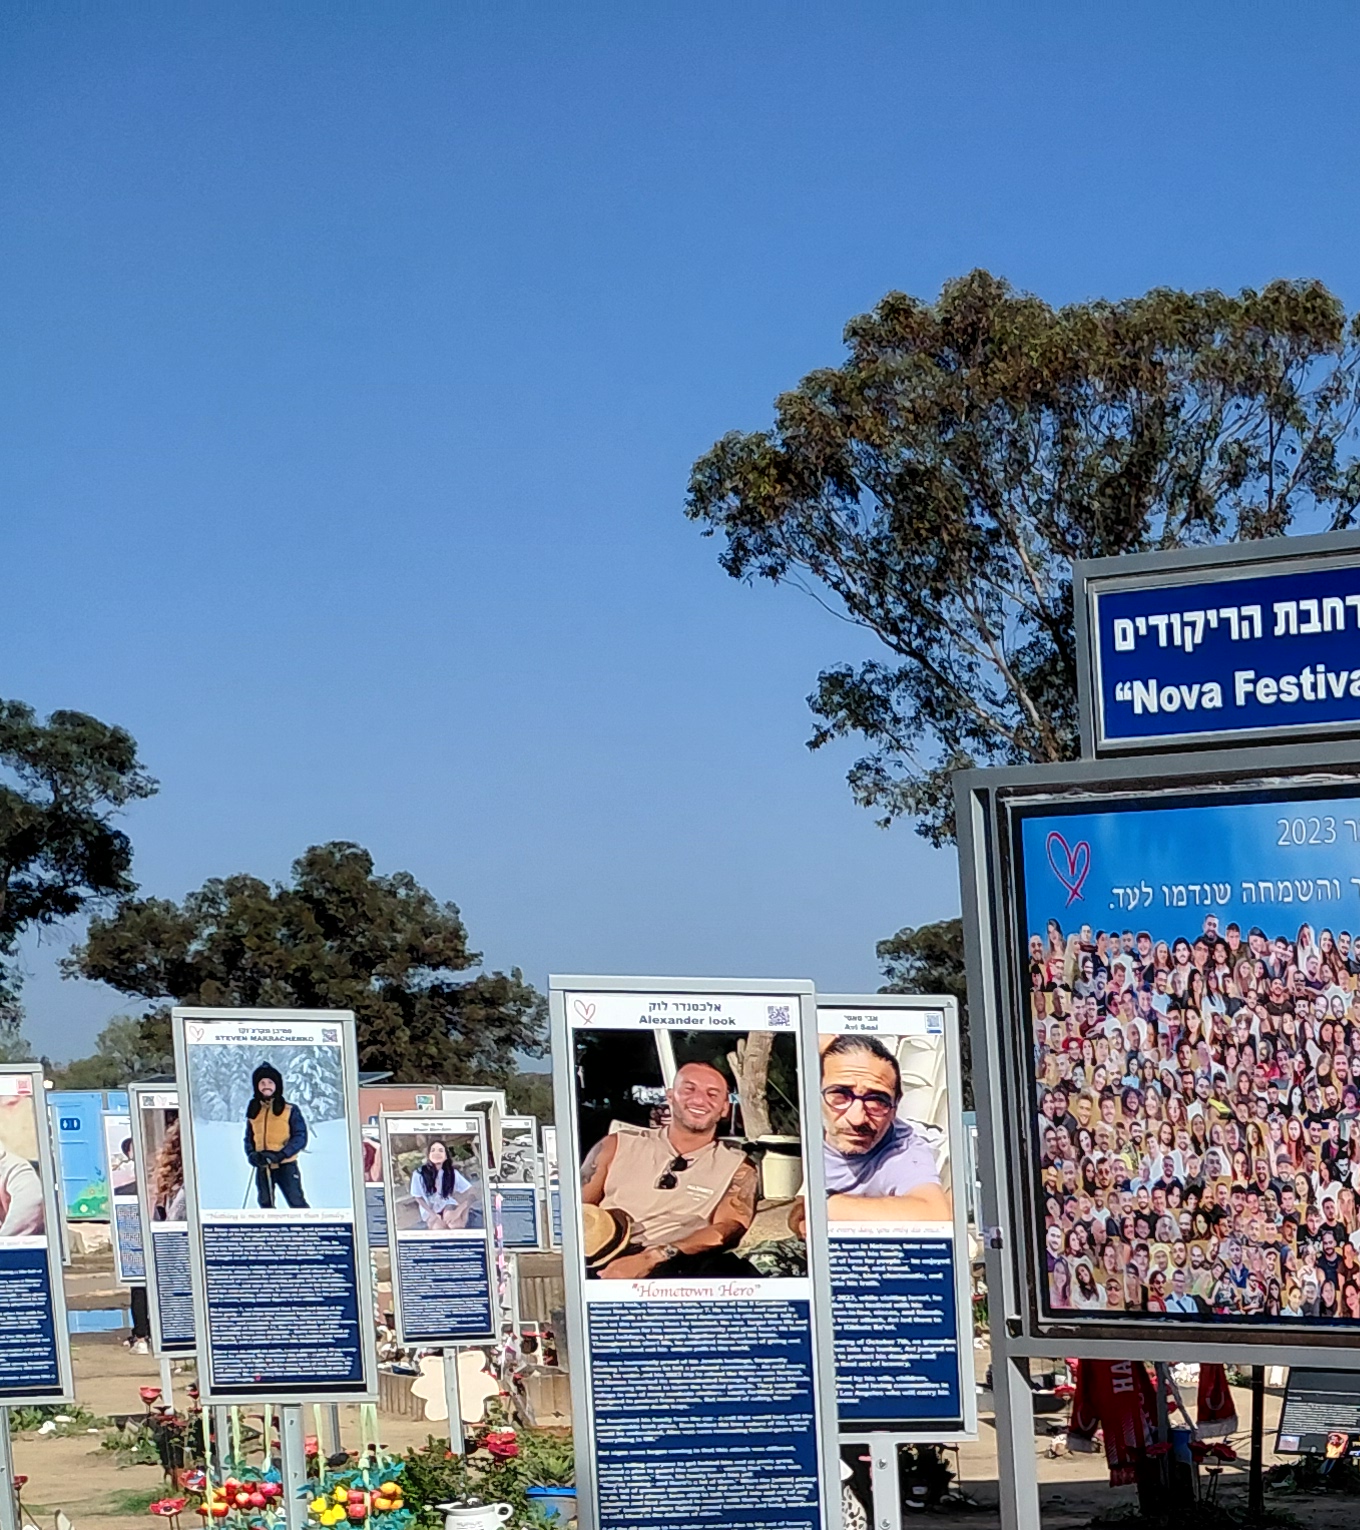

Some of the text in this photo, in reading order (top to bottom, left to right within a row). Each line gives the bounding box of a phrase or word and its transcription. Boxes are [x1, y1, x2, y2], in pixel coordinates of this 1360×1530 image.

[1113, 604, 1264, 652] הריקודים
[1114, 679, 1223, 715] “Nova
[1277, 815, 1337, 846] 2023
[1108, 880, 1153, 911] לעד.
[1161, 882, 1231, 908] שנדמו
[1241, 878, 1341, 904] והשמחה
[639, 1015, 736, 1026] Alexander look
[648, 1001, 721, 1014] אלכסנדר לוק
